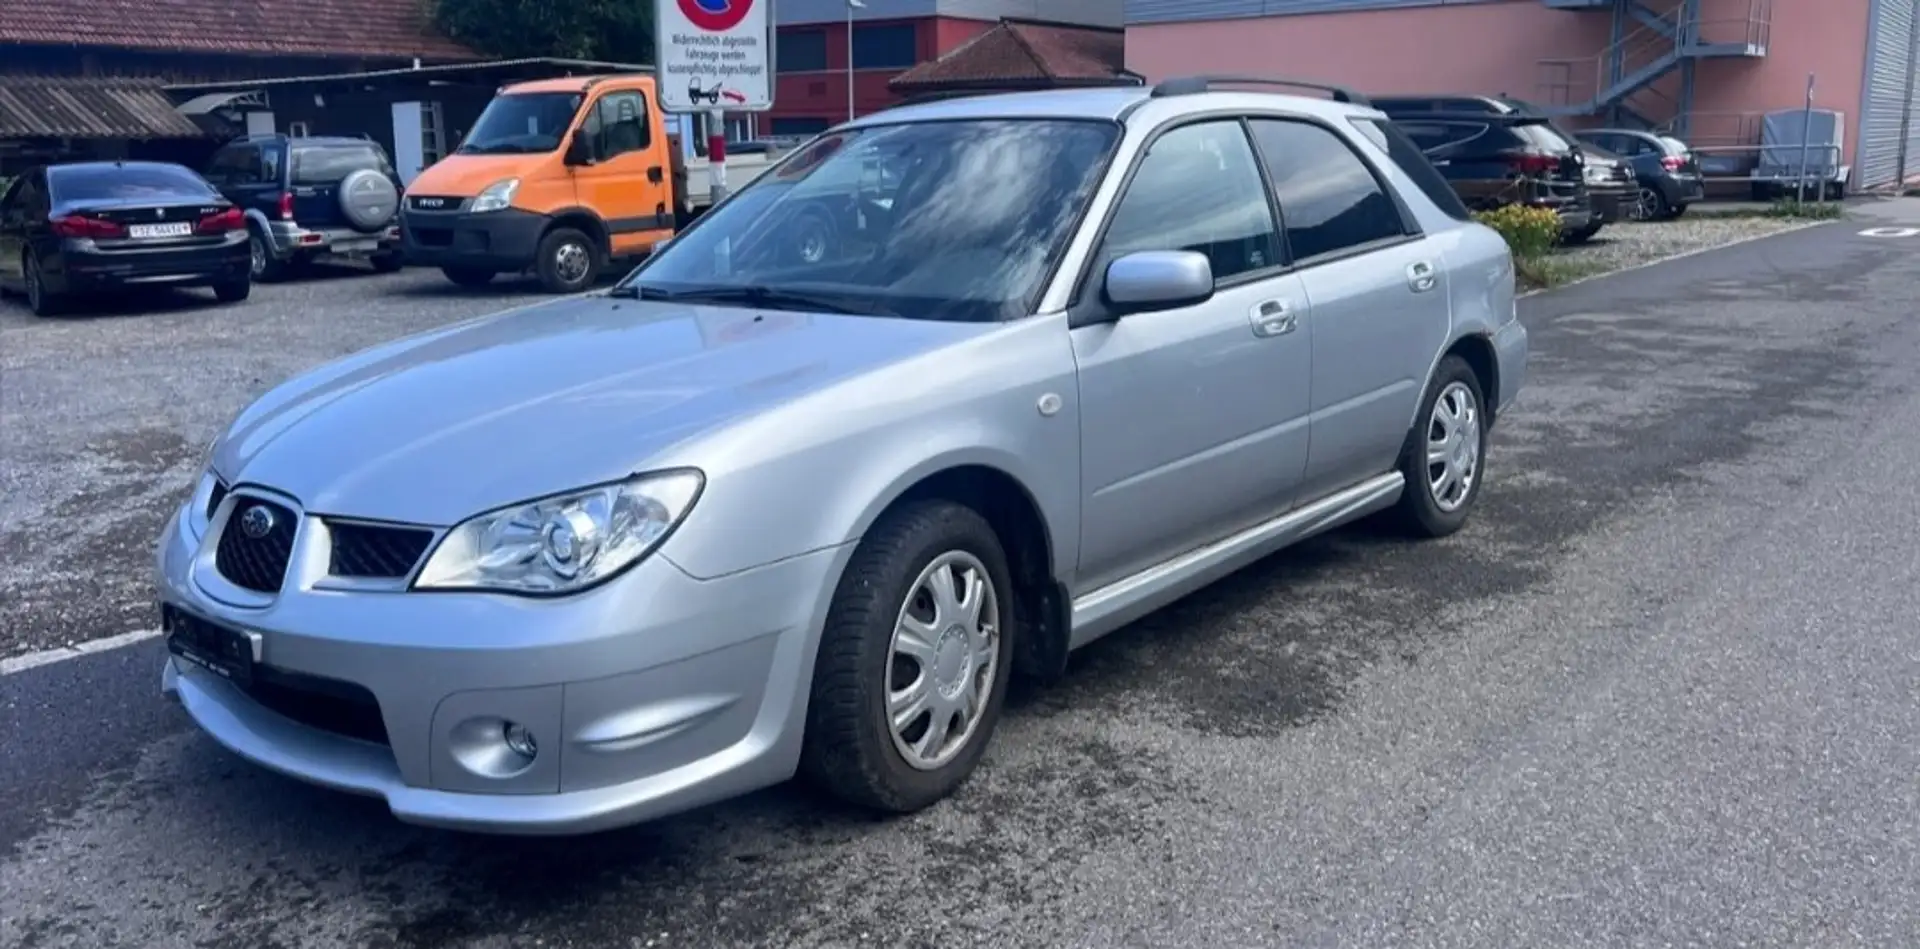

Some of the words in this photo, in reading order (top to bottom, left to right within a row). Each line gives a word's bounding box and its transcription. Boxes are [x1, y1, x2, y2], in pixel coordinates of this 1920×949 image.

[672, 34, 720, 46] Widerrechch
[722, 36, 757, 48] abgell
[667, 62, 717, 75] ktnpflchg
[719, 62, 762, 76] abgechpp
